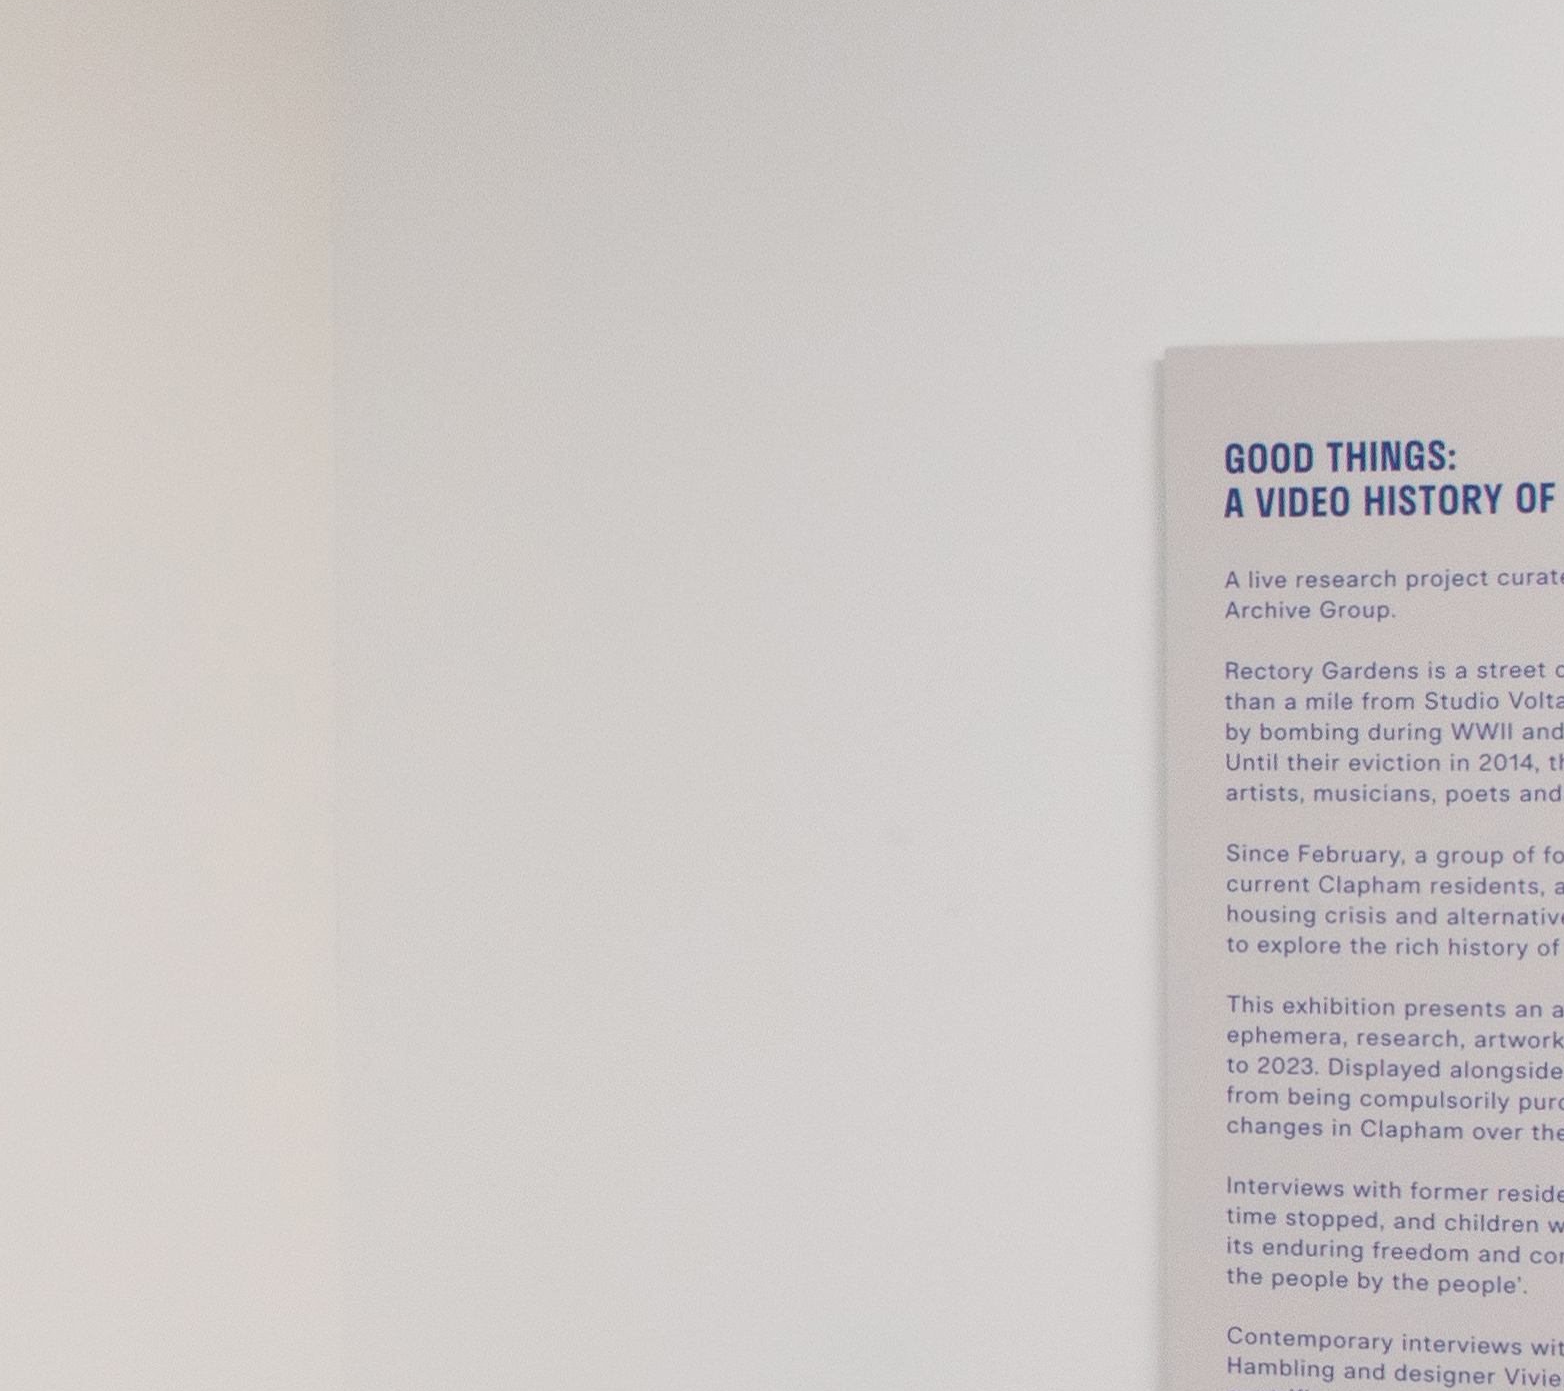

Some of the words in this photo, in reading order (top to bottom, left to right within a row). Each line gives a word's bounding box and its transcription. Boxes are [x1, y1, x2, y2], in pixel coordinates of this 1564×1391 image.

[1223, 440, 1316, 476] GOOD
[1325, 437, 1458, 473] THINGS:
[1223, 485, 1246, 520] A
[1255, 485, 1352, 519] VIDEO
[1363, 481, 1505, 518] HISTORY
[1514, 480, 1558, 516] OF
[1223, 569, 1242, 590] A
[1248, 569, 1289, 590] live
[1295, 568, 1398, 589] research
[1405, 568, 1490, 593] project
[1224, 600, 1312, 621] Archive
[1318, 599, 1397, 624] Group.
[1225, 842, 1291, 864] Since
[1297, 843, 1406, 869] February,
[1414, 848, 1429, 865] a
[1435, 849, 1505, 870] group
[1511, 844, 1536, 865] of
[1225, 876, 1310, 894] current
[1318, 874, 1422, 898] Clapham
[1430, 876, 1546, 897] residents,
[1226, 903, 1317, 929] housing
[1324, 909, 1388, 925] crisis
[1395, 906, 1438, 926] and
[1225, 936, 1250, 954] to
[1256, 935, 1343, 959] explore
[1349, 936, 1388, 956] the
[1395, 937, 1440, 957] rich
[1447, 937, 1530, 962] history
[1536, 937, 1561, 958] of
